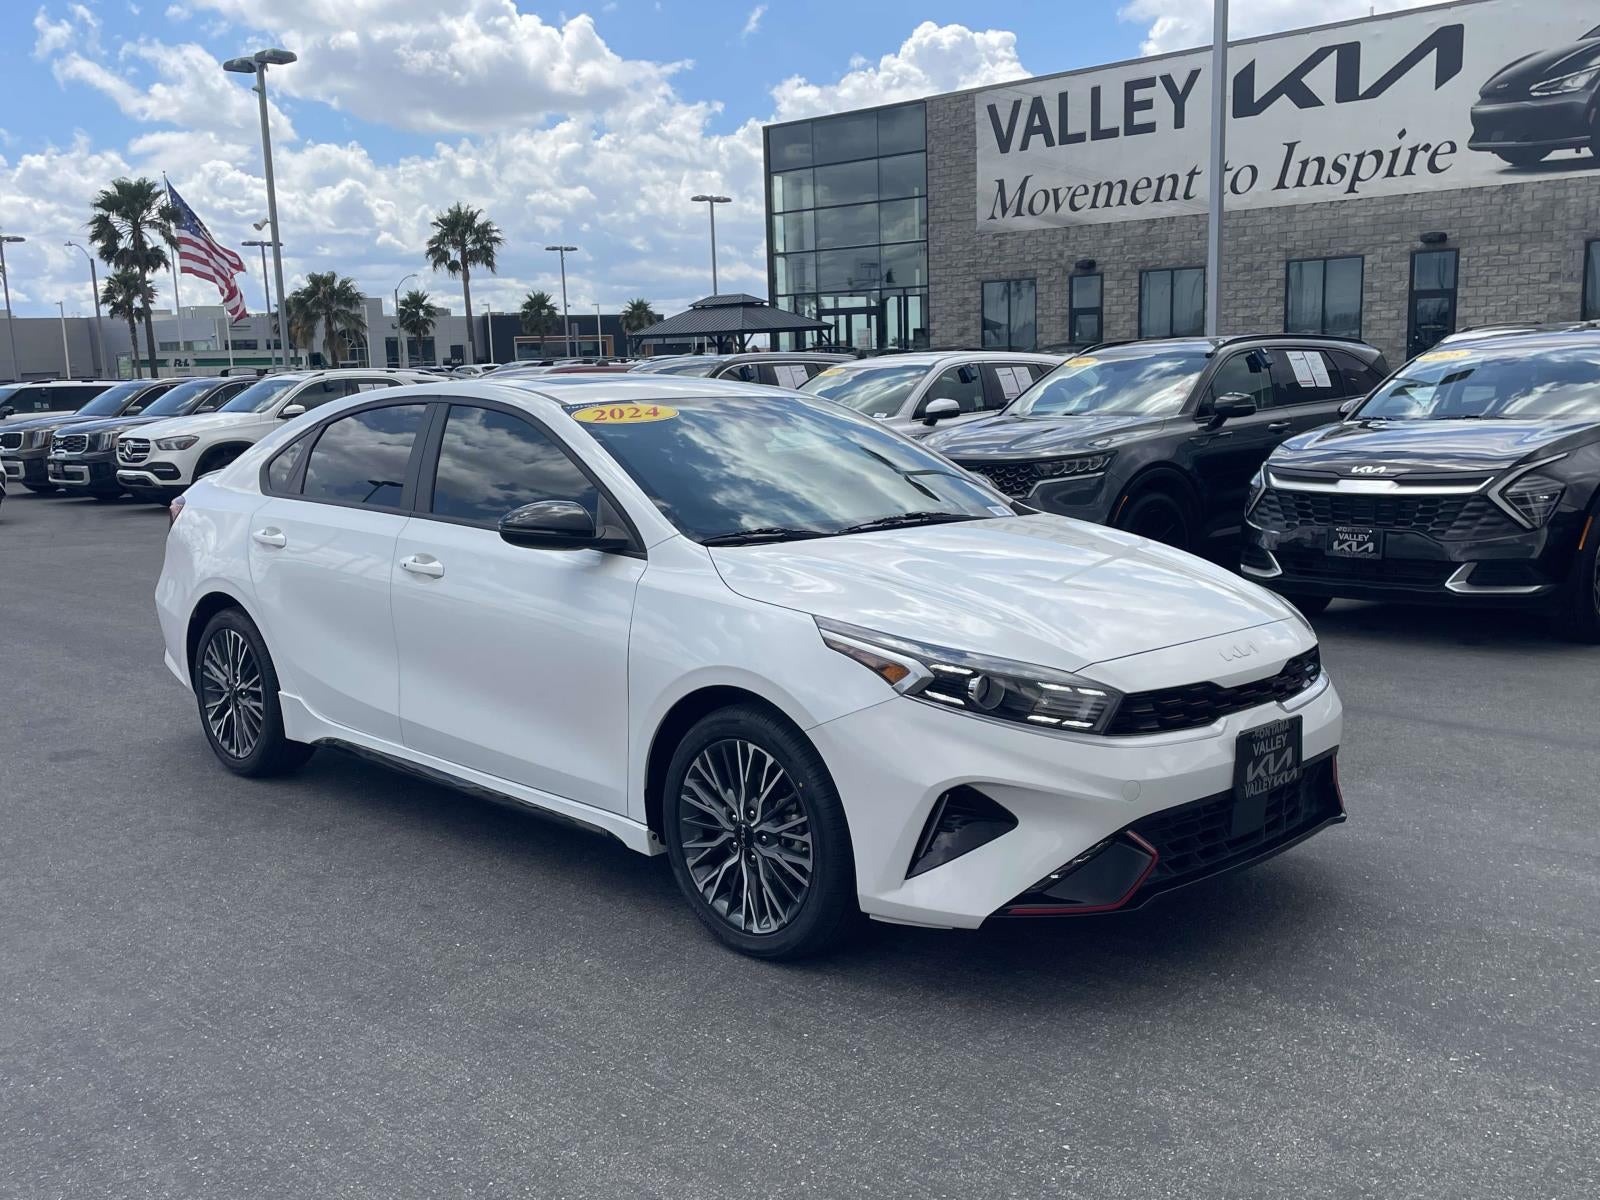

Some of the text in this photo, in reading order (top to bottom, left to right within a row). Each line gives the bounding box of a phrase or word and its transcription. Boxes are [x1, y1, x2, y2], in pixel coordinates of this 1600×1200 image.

[987, 23, 1465, 154] VALLEY KIA
[987, 164, 1203, 221] Movement
[1272, 128, 1458, 194] Inspire
[594, 406, 660, 421] 2024
[1351, 465, 1387, 474] KIA
[1333, 540, 1375, 553] KIA
[1338, 532, 1370, 542] VALLEY
[1252, 733, 1288, 757] VALLEY
[1246, 746, 1293, 783] KIA
[1244, 776, 1273, 799] VALLEY
